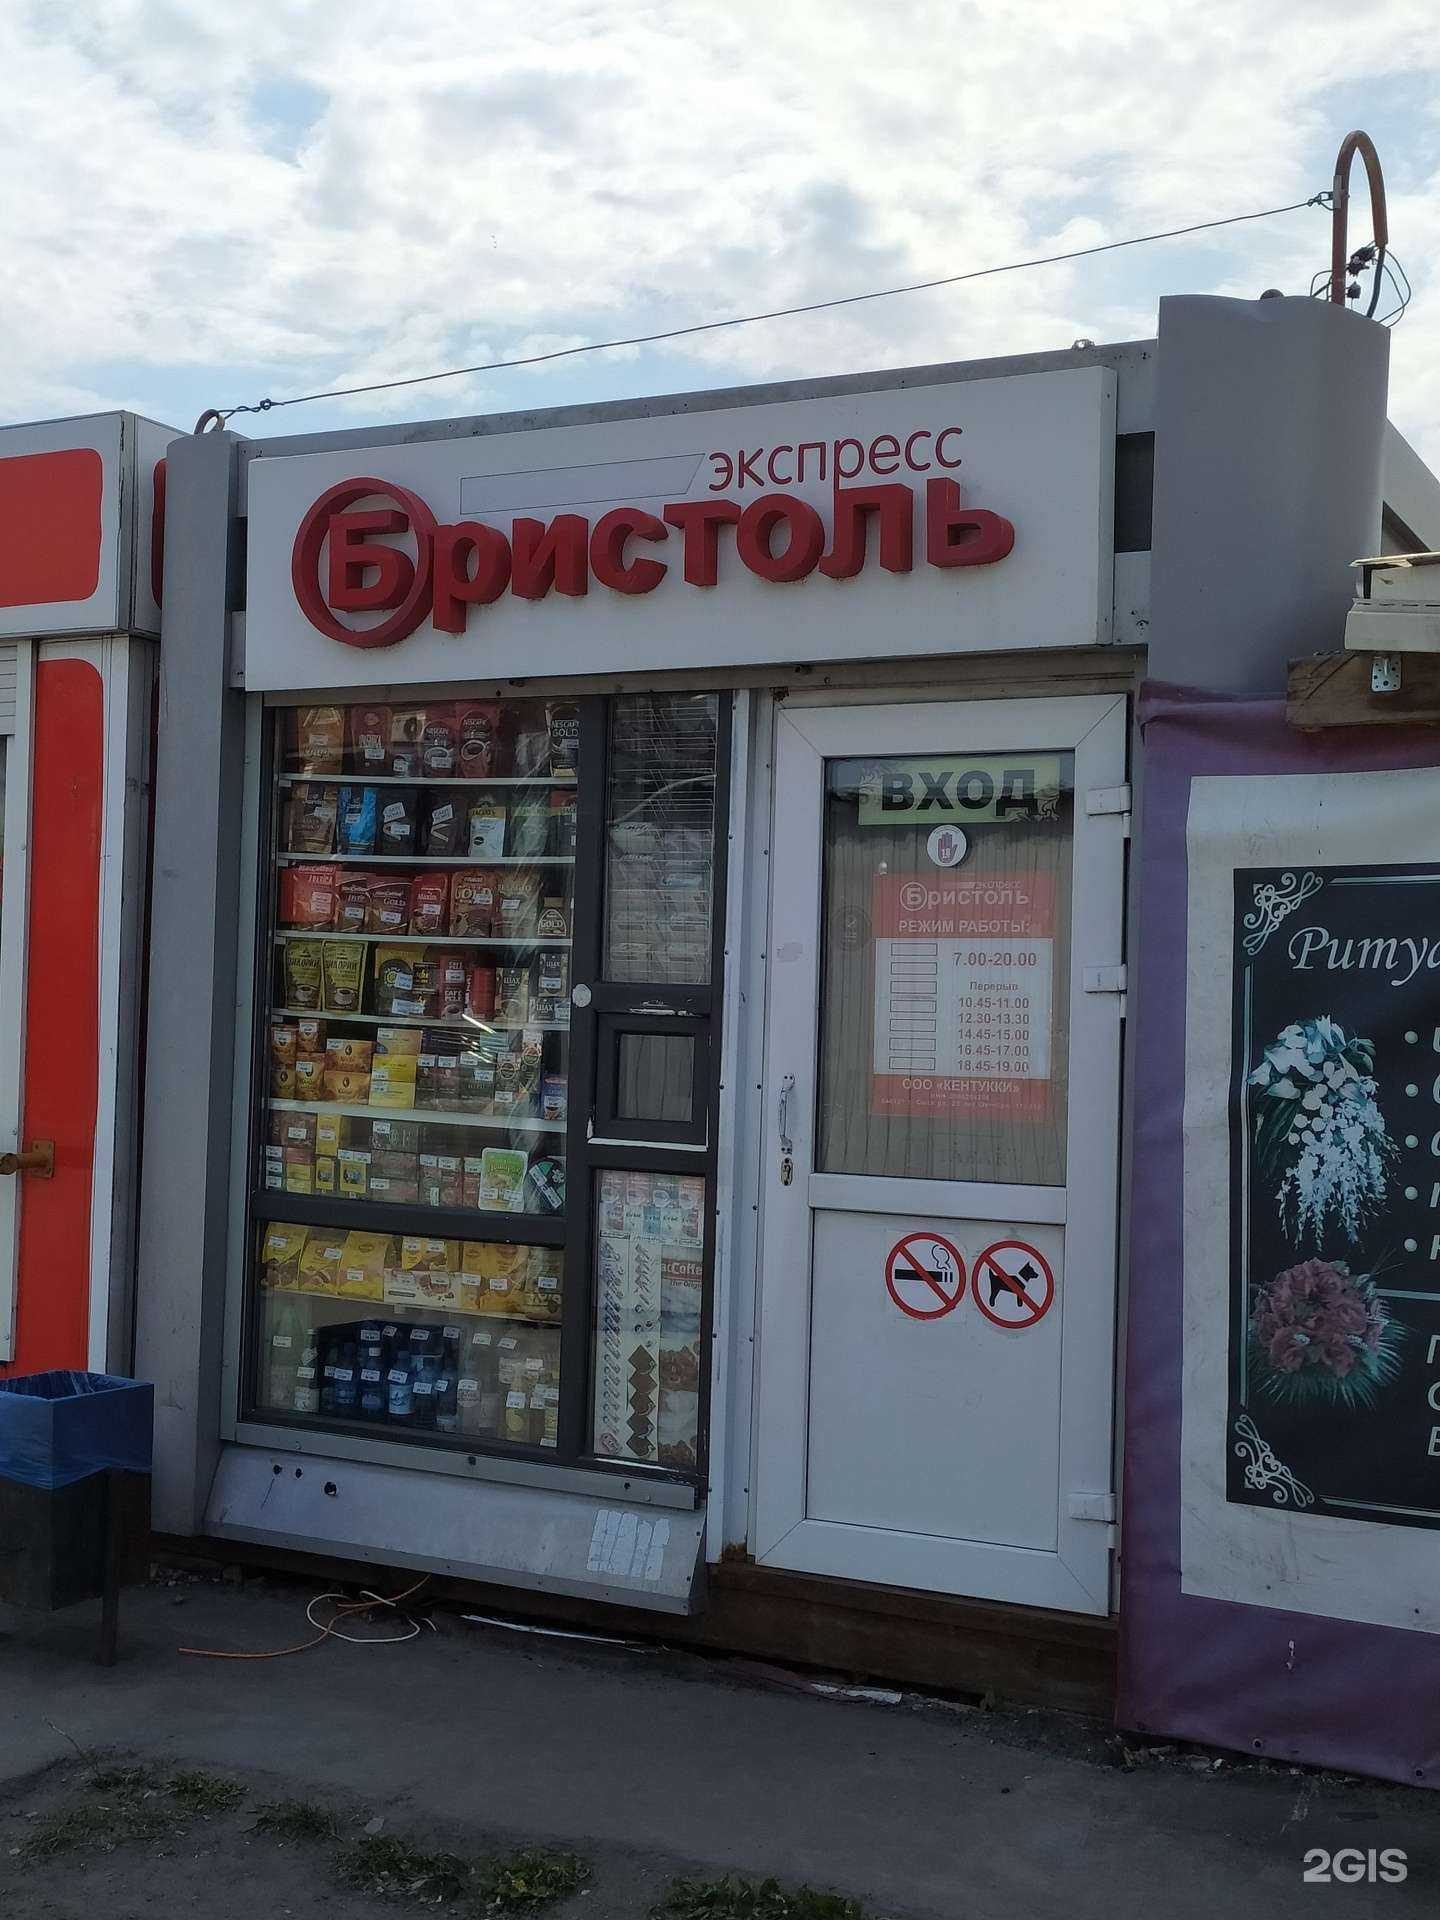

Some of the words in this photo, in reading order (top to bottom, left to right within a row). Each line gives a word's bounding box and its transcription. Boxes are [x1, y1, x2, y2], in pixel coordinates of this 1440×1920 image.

[708, 427, 963, 491] экспресс
[292, 476, 1015, 648] Бристоль
[552, 728, 578, 737] GOLD
[881, 769, 1040, 817] ВХОД
[900, 881, 1029, 912] Бристоль
[899, 920, 954, 933] РЕЖИМ
[953, 952, 1037, 967] 7.00-20.00
[969, 981, 1019, 992] Перерыв
[959, 997, 1030, 1009] 10.45-11.00
[959, 1013, 1030, 1025] 12.30-13.30
[958, 1029, 1030, 1041] 14.45-15.00
[958, 1044, 1030, 1057] 16.45-17.00
[957, 1060, 1030, 1073] 18.45-19.00
